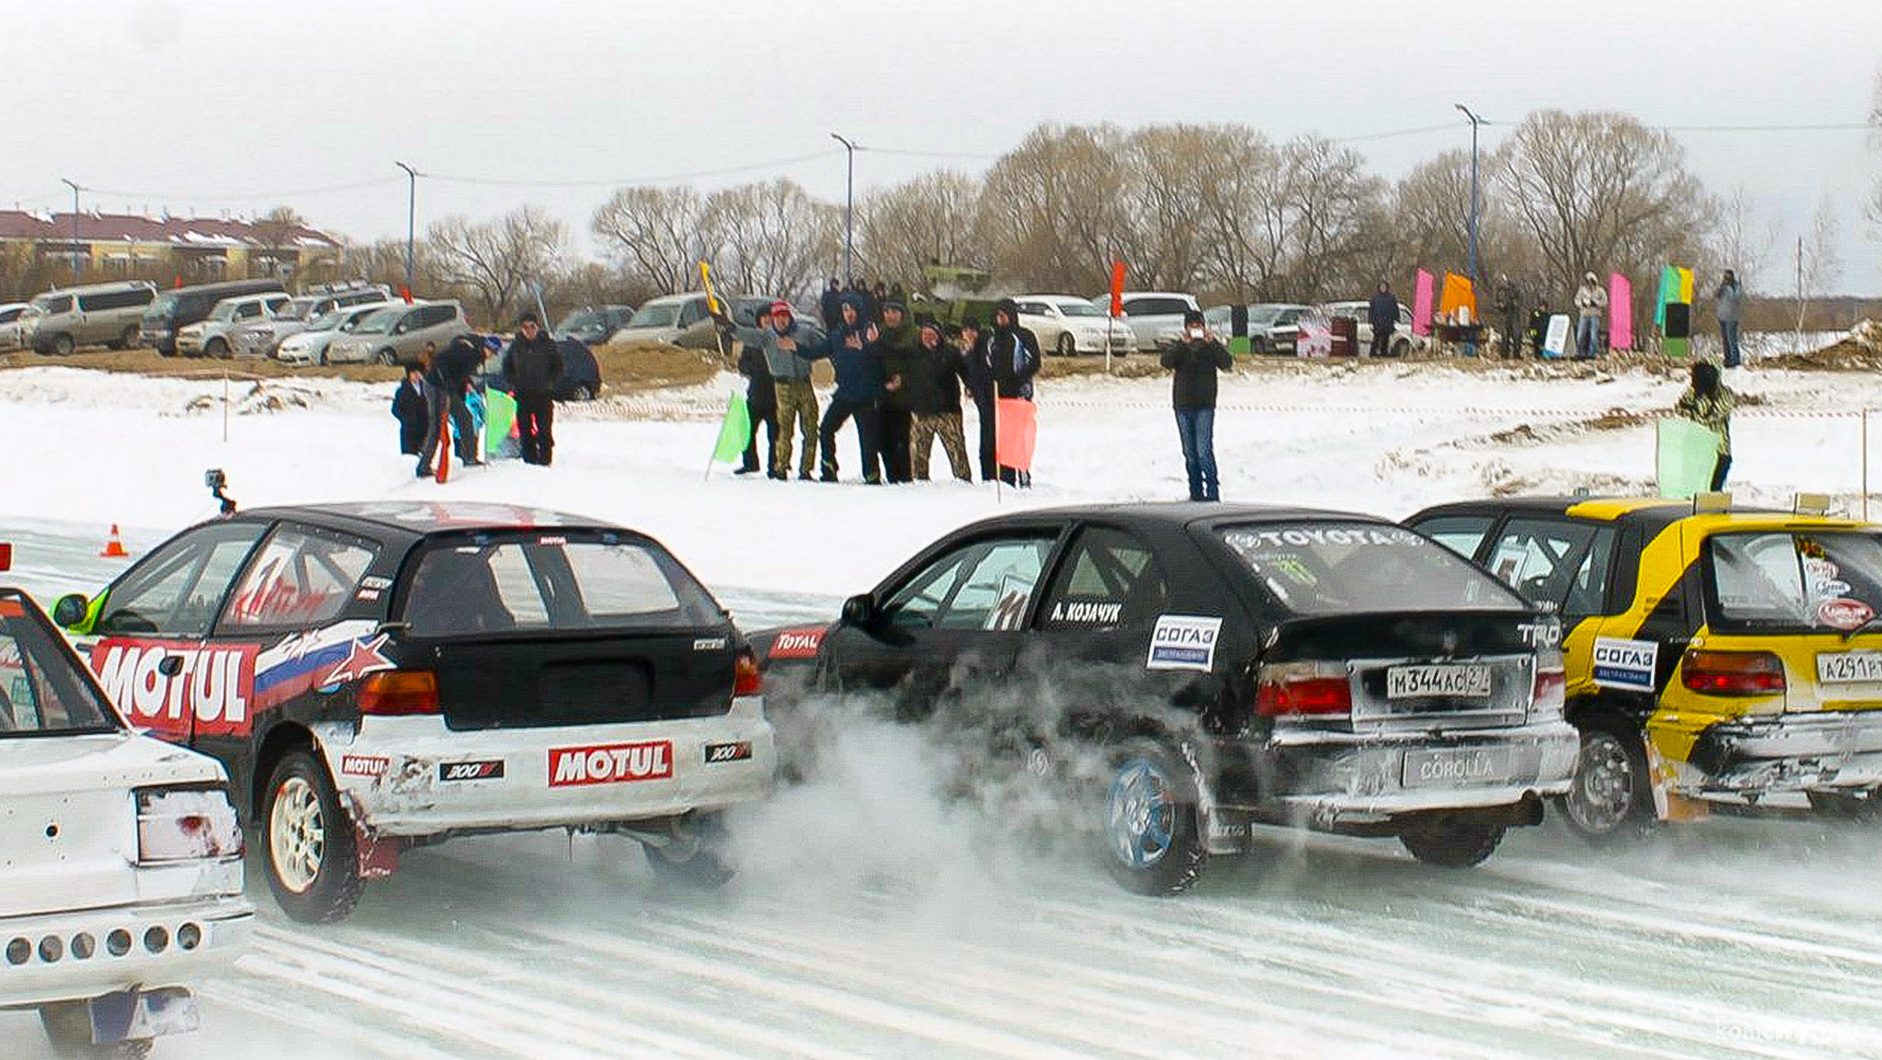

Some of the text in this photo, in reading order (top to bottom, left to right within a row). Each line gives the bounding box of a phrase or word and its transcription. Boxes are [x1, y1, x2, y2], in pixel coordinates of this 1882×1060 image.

[1260, 530, 1392, 546] TOYOTA
[1051, 602, 1122, 622] А. КОЗАЧУК
[777, 633, 818, 650] TOTAL
[1156, 627, 1215, 643] СОГАЗ
[1596, 648, 1653, 665] СОГАЗ
[101, 646, 245, 722] MOTUL
[555, 746, 669, 783] MOTUL
[1421, 756, 1494, 780] COROLLA
